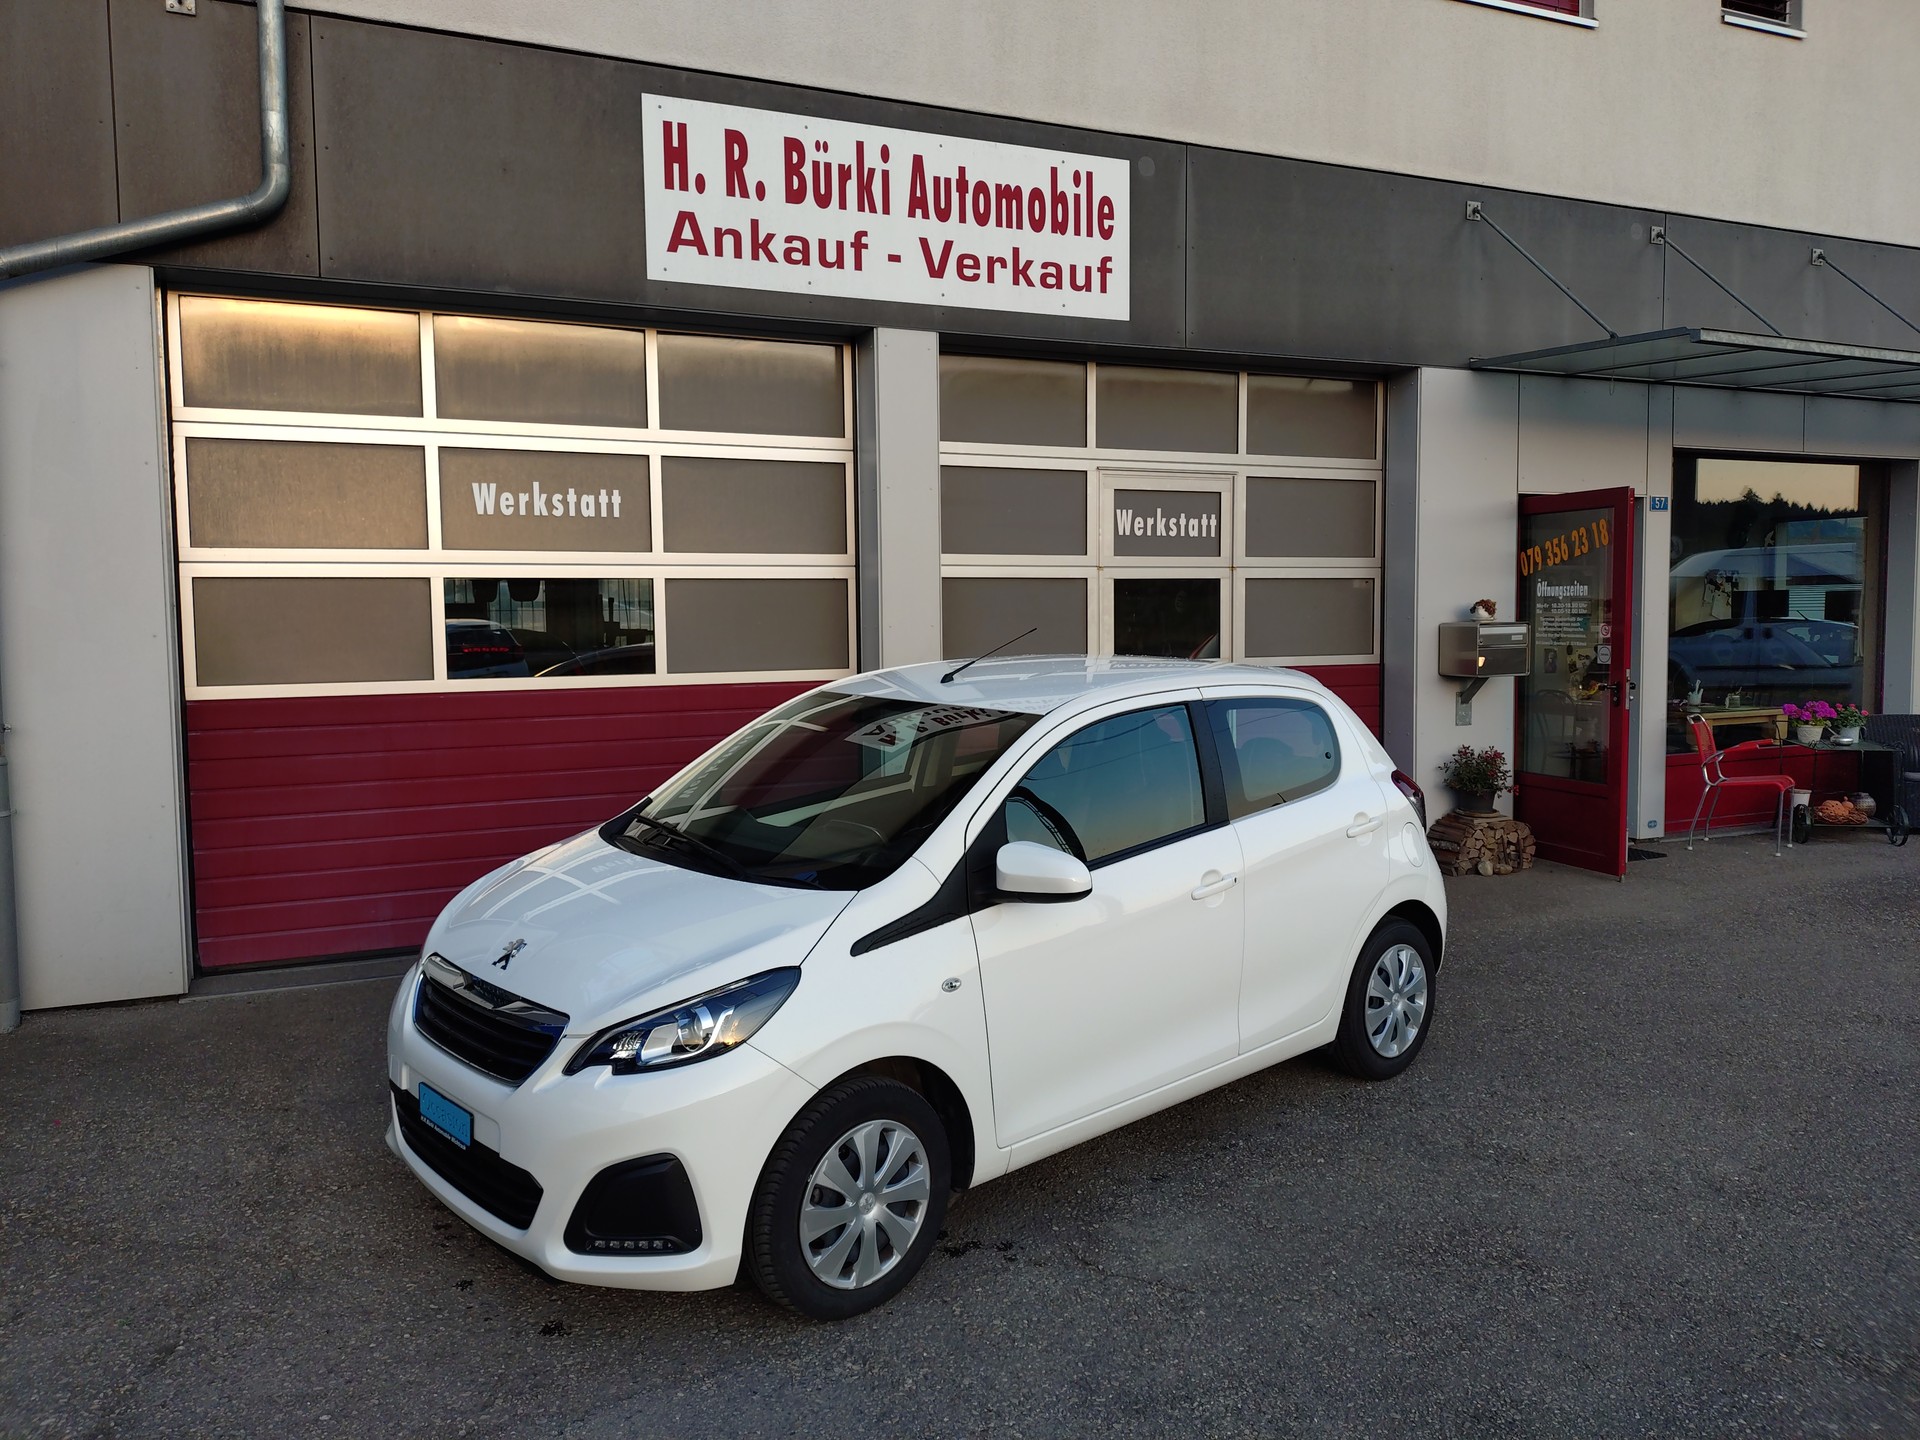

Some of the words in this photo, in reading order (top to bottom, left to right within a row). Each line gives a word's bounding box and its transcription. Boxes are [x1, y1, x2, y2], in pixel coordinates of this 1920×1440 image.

[663, 120, 706, 195] H.
[724, 128, 766, 201] R.
[783, 136, 890, 215] Bürki
[907, 154, 1115, 240] Automobile
[667, 210, 868, 272] Ankauf
[919, 237, 1113, 294] Verkauf
[471, 481, 623, 518] Werkstatt
[1655, 497, 1664, 509] 57
[1116, 507, 1218, 538] Werkstatt
[1520, 545, 1543, 577] 079
[1545, 535, 1569, 567] 356
[1571, 526, 1589, 557] 23
[1592, 518, 1609, 548] 18
[1536, 578, 1589, 599] Öffnungszeiten
